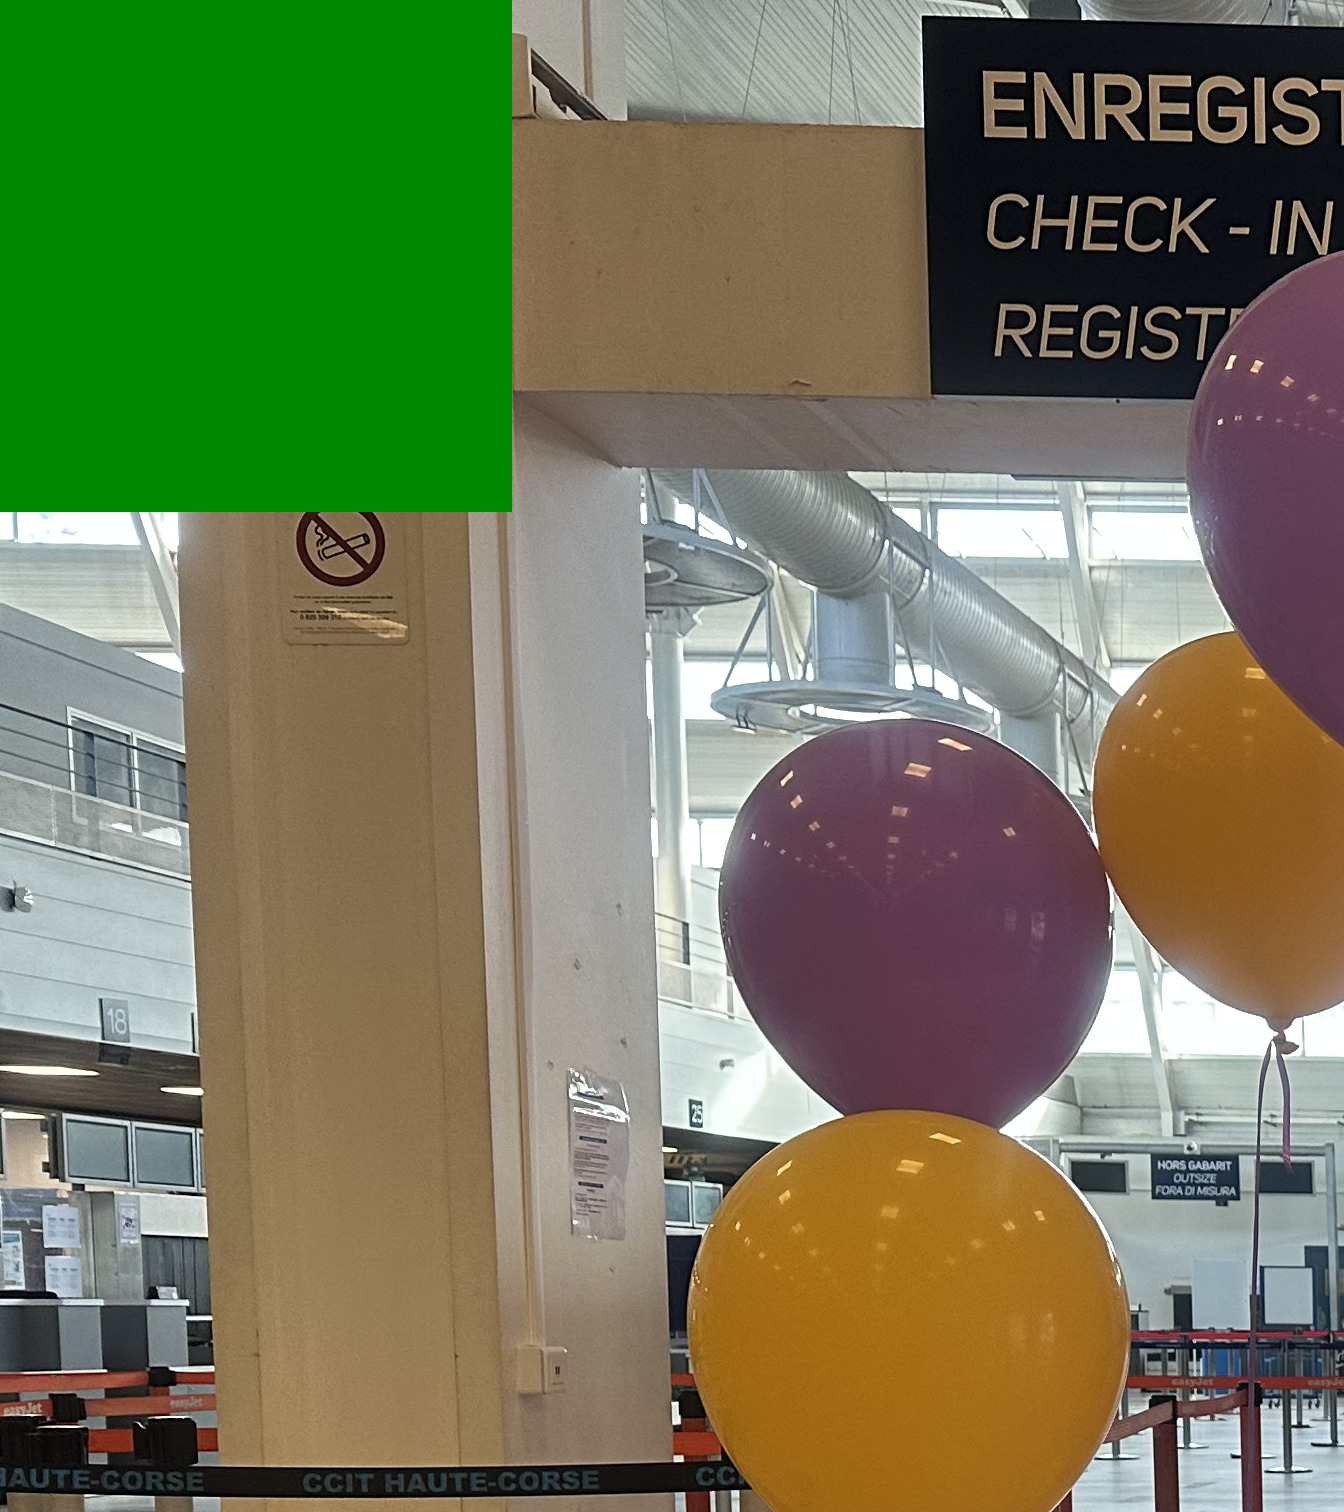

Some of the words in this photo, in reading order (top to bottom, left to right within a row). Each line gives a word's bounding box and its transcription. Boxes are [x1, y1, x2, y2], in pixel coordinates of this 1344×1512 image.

[986, 193, 1217, 254] CHECK
[1269, 199, 1335, 256] IN
[993, 303, 1243, 361] REGIST
[107, 1008, 127, 1034] 18
[691, 1103, 703, 1124] 25
[1157, 1160, 1187, 1171] HORS
[1188, 1160, 1232, 1171] GABARIT
[1173, 1172, 1218, 1184] OUTSIZE
[1155, 1184, 1184, 1196] FORA
[1184, 1185, 1195, 1196] DI
[1197, 1185, 1237, 1197] MISURA
[3, 1401, 43, 1415] easyJet
[169, 1396, 203, 1410] easyJet
[302, 1472, 374, 1493] CCIT
[385, 1470, 600, 1493] HAUTE-CORSE
